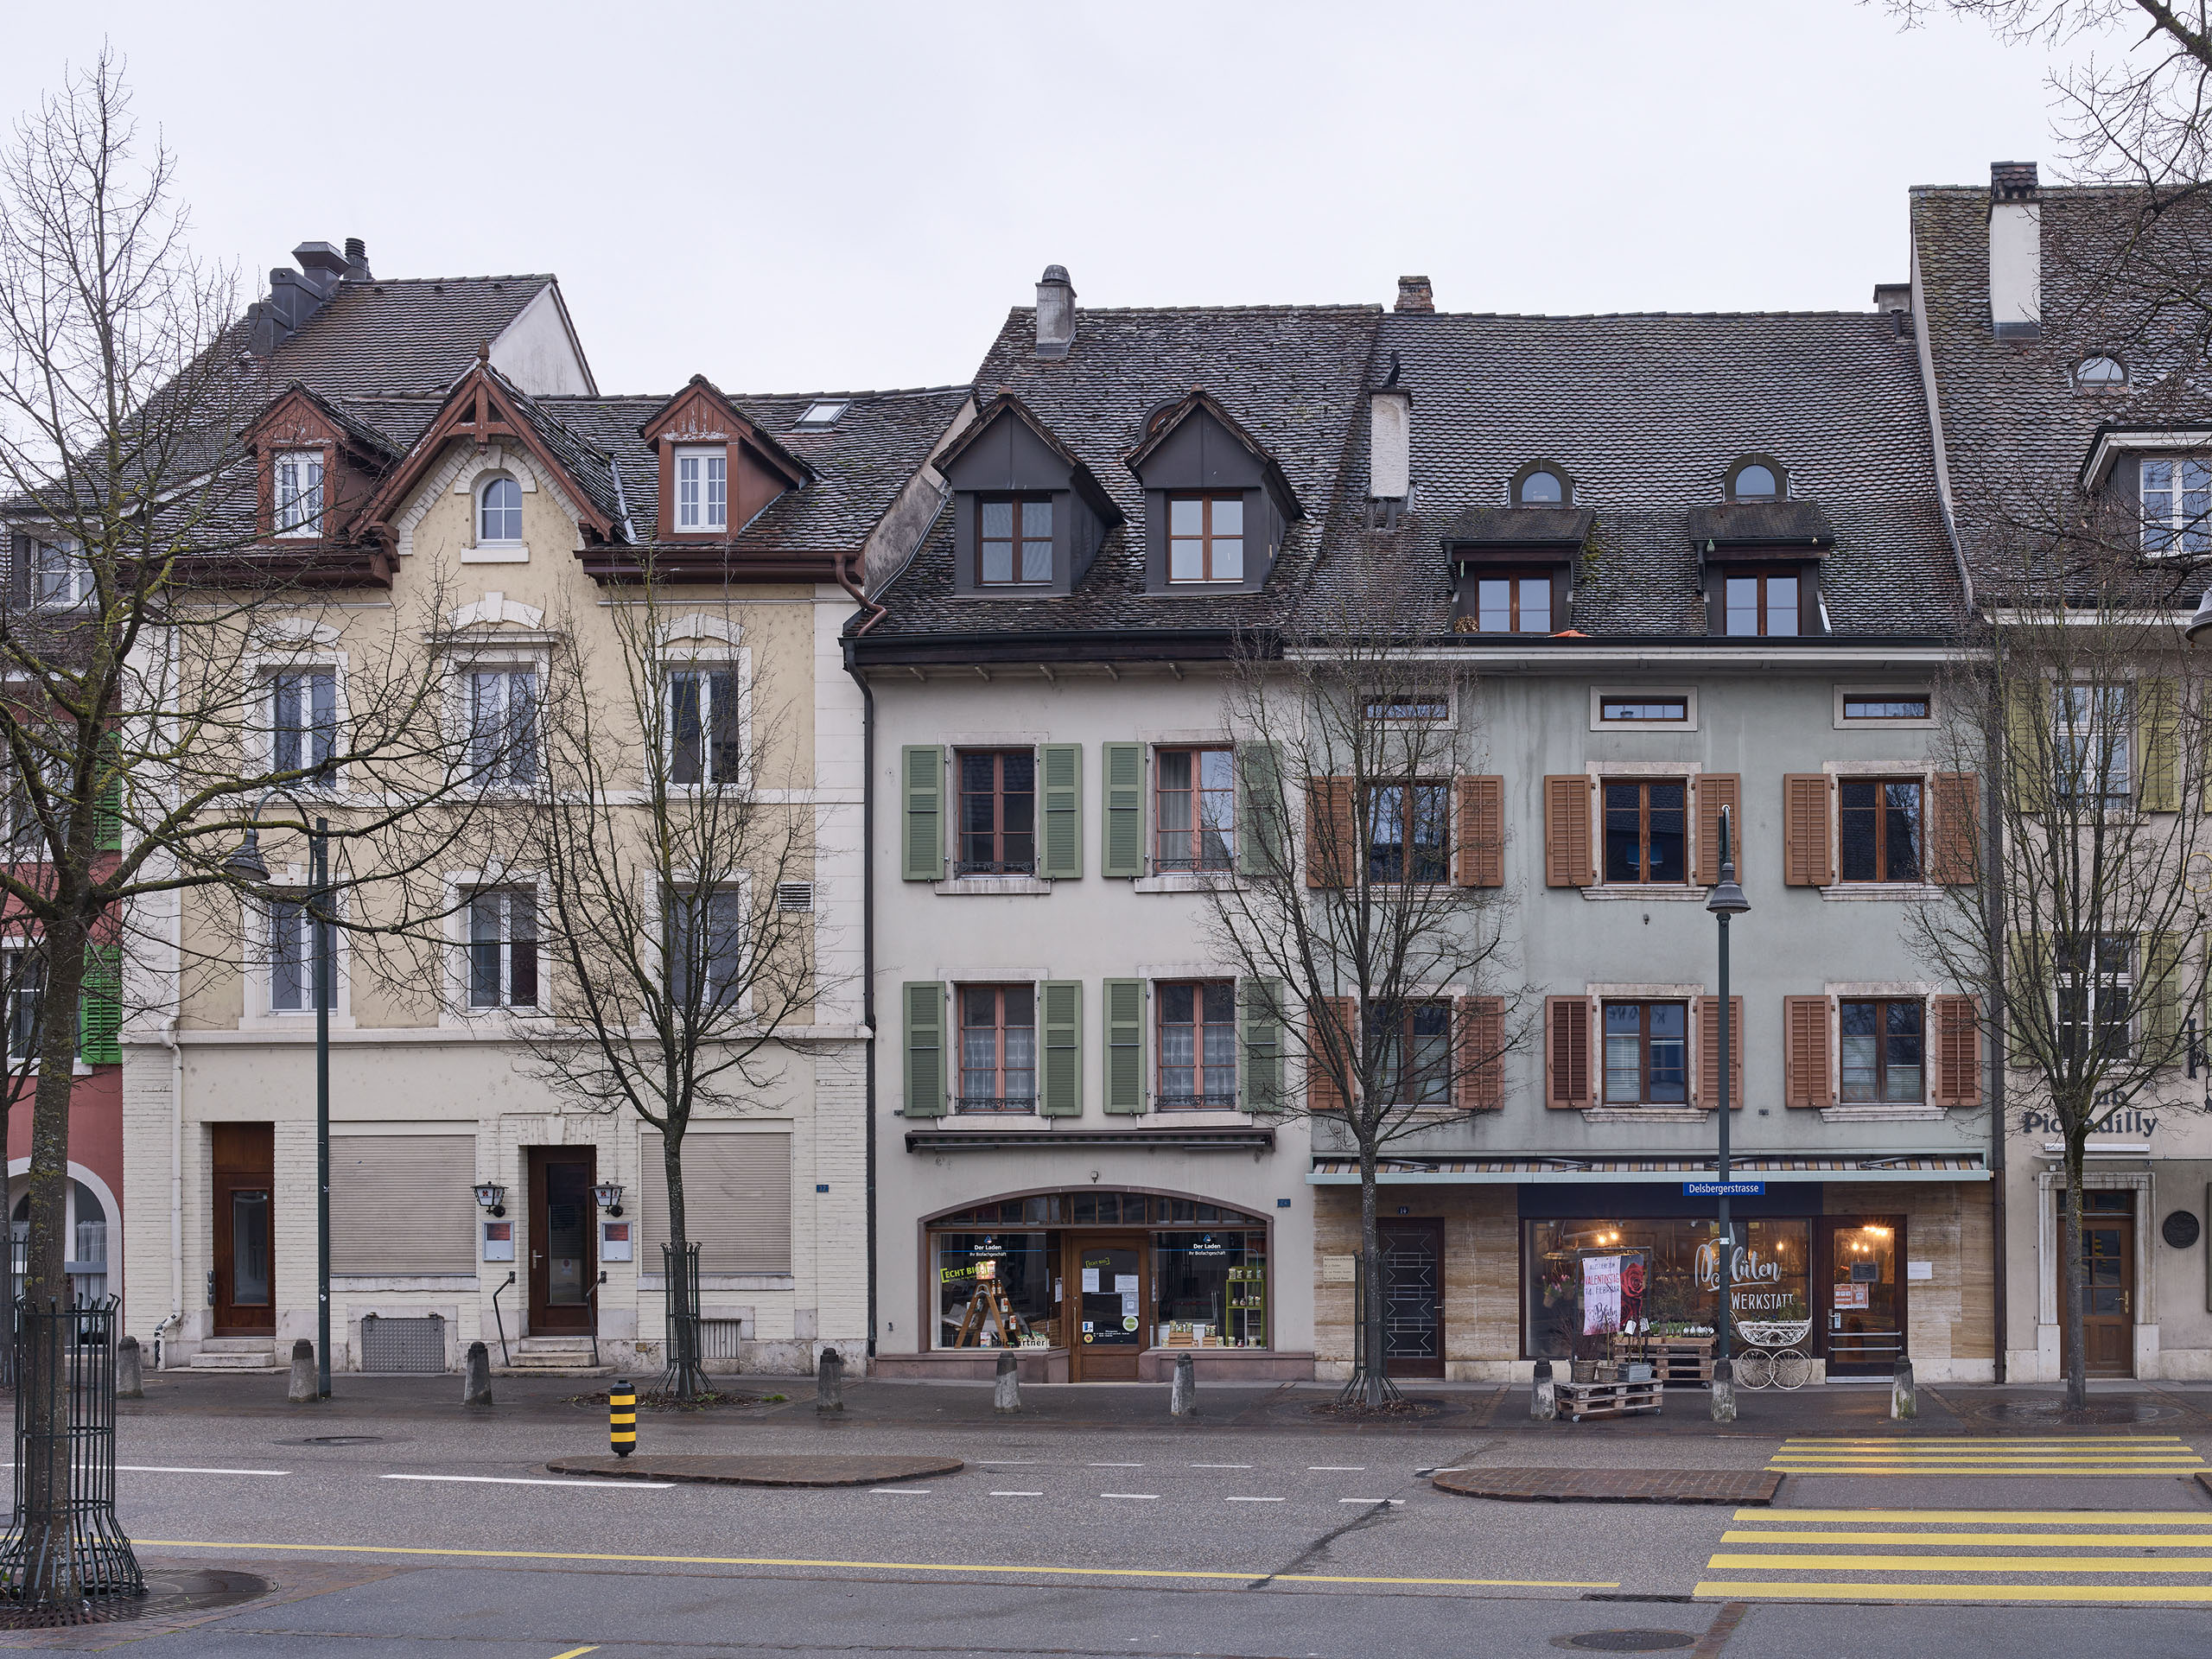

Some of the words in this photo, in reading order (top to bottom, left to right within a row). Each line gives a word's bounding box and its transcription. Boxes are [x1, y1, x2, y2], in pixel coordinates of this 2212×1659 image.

[2023, 1111, 2158, 1137] Picadilly
[1688, 1183, 1759, 1195] Delsbergerstrasse
[944, 1268, 965, 1279] ECHT
[1586, 1273, 1619, 1286] VALENTINSTAG
[1731, 1293, 1794, 1310] WERKSTATT
